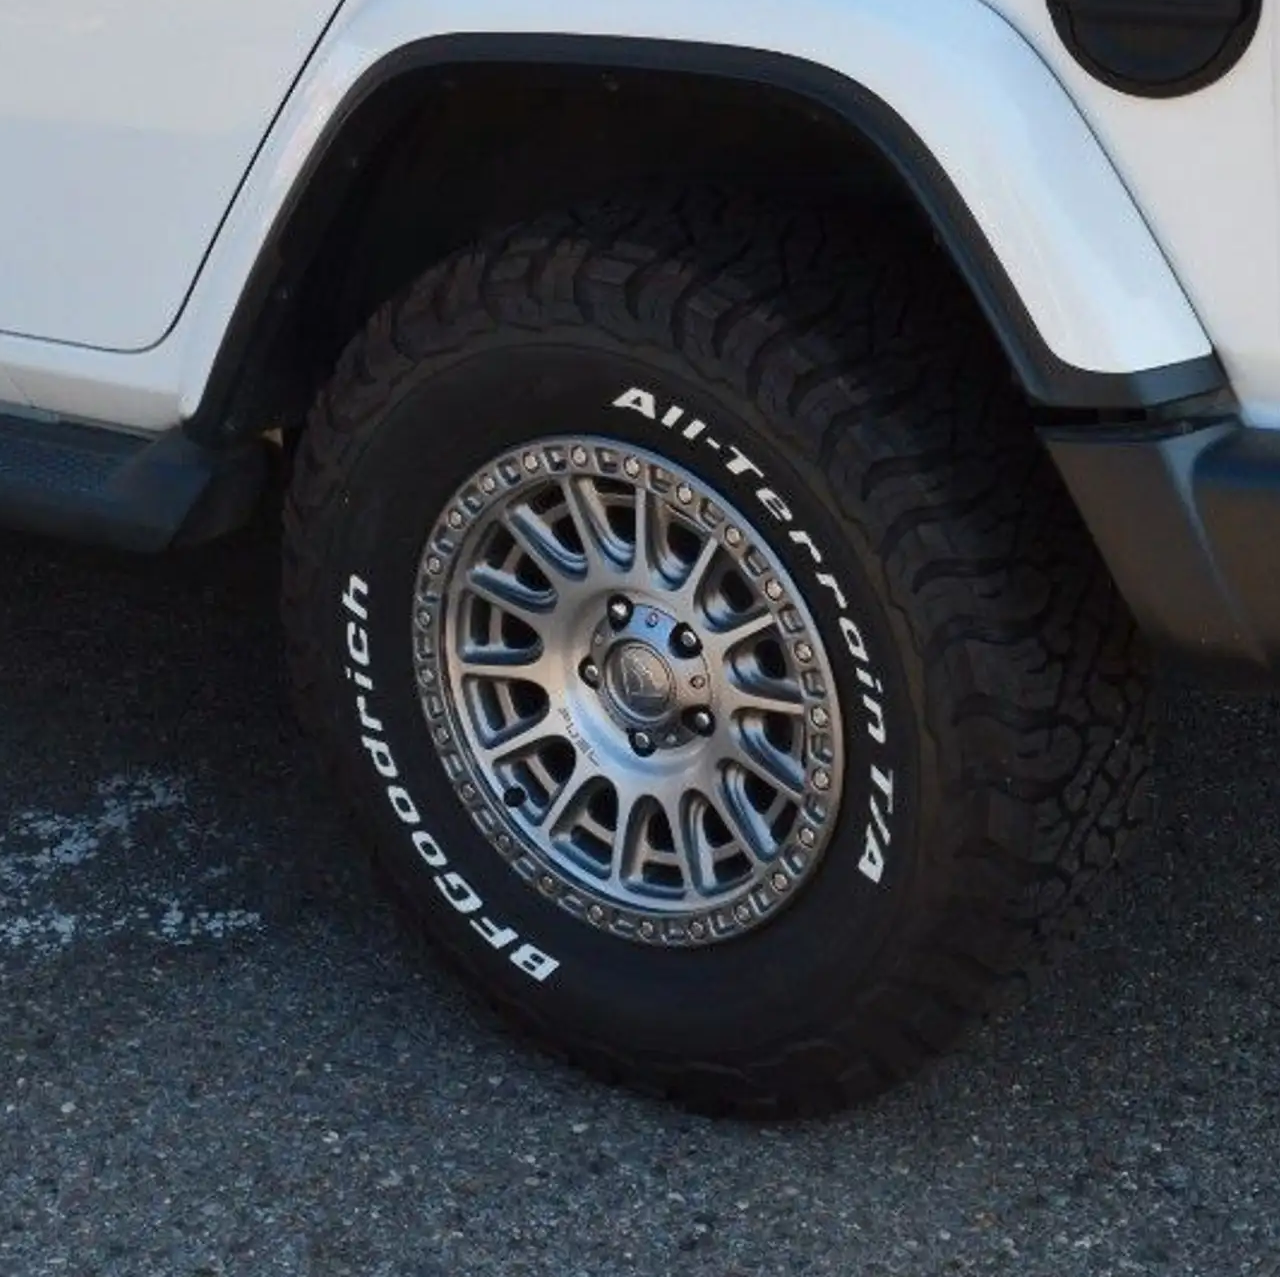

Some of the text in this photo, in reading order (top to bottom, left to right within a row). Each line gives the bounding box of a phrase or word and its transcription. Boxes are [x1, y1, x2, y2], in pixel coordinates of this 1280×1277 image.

[336, 572, 561, 984] BFGoodrich
[611, 385, 894, 887] All-Terrain T/A
